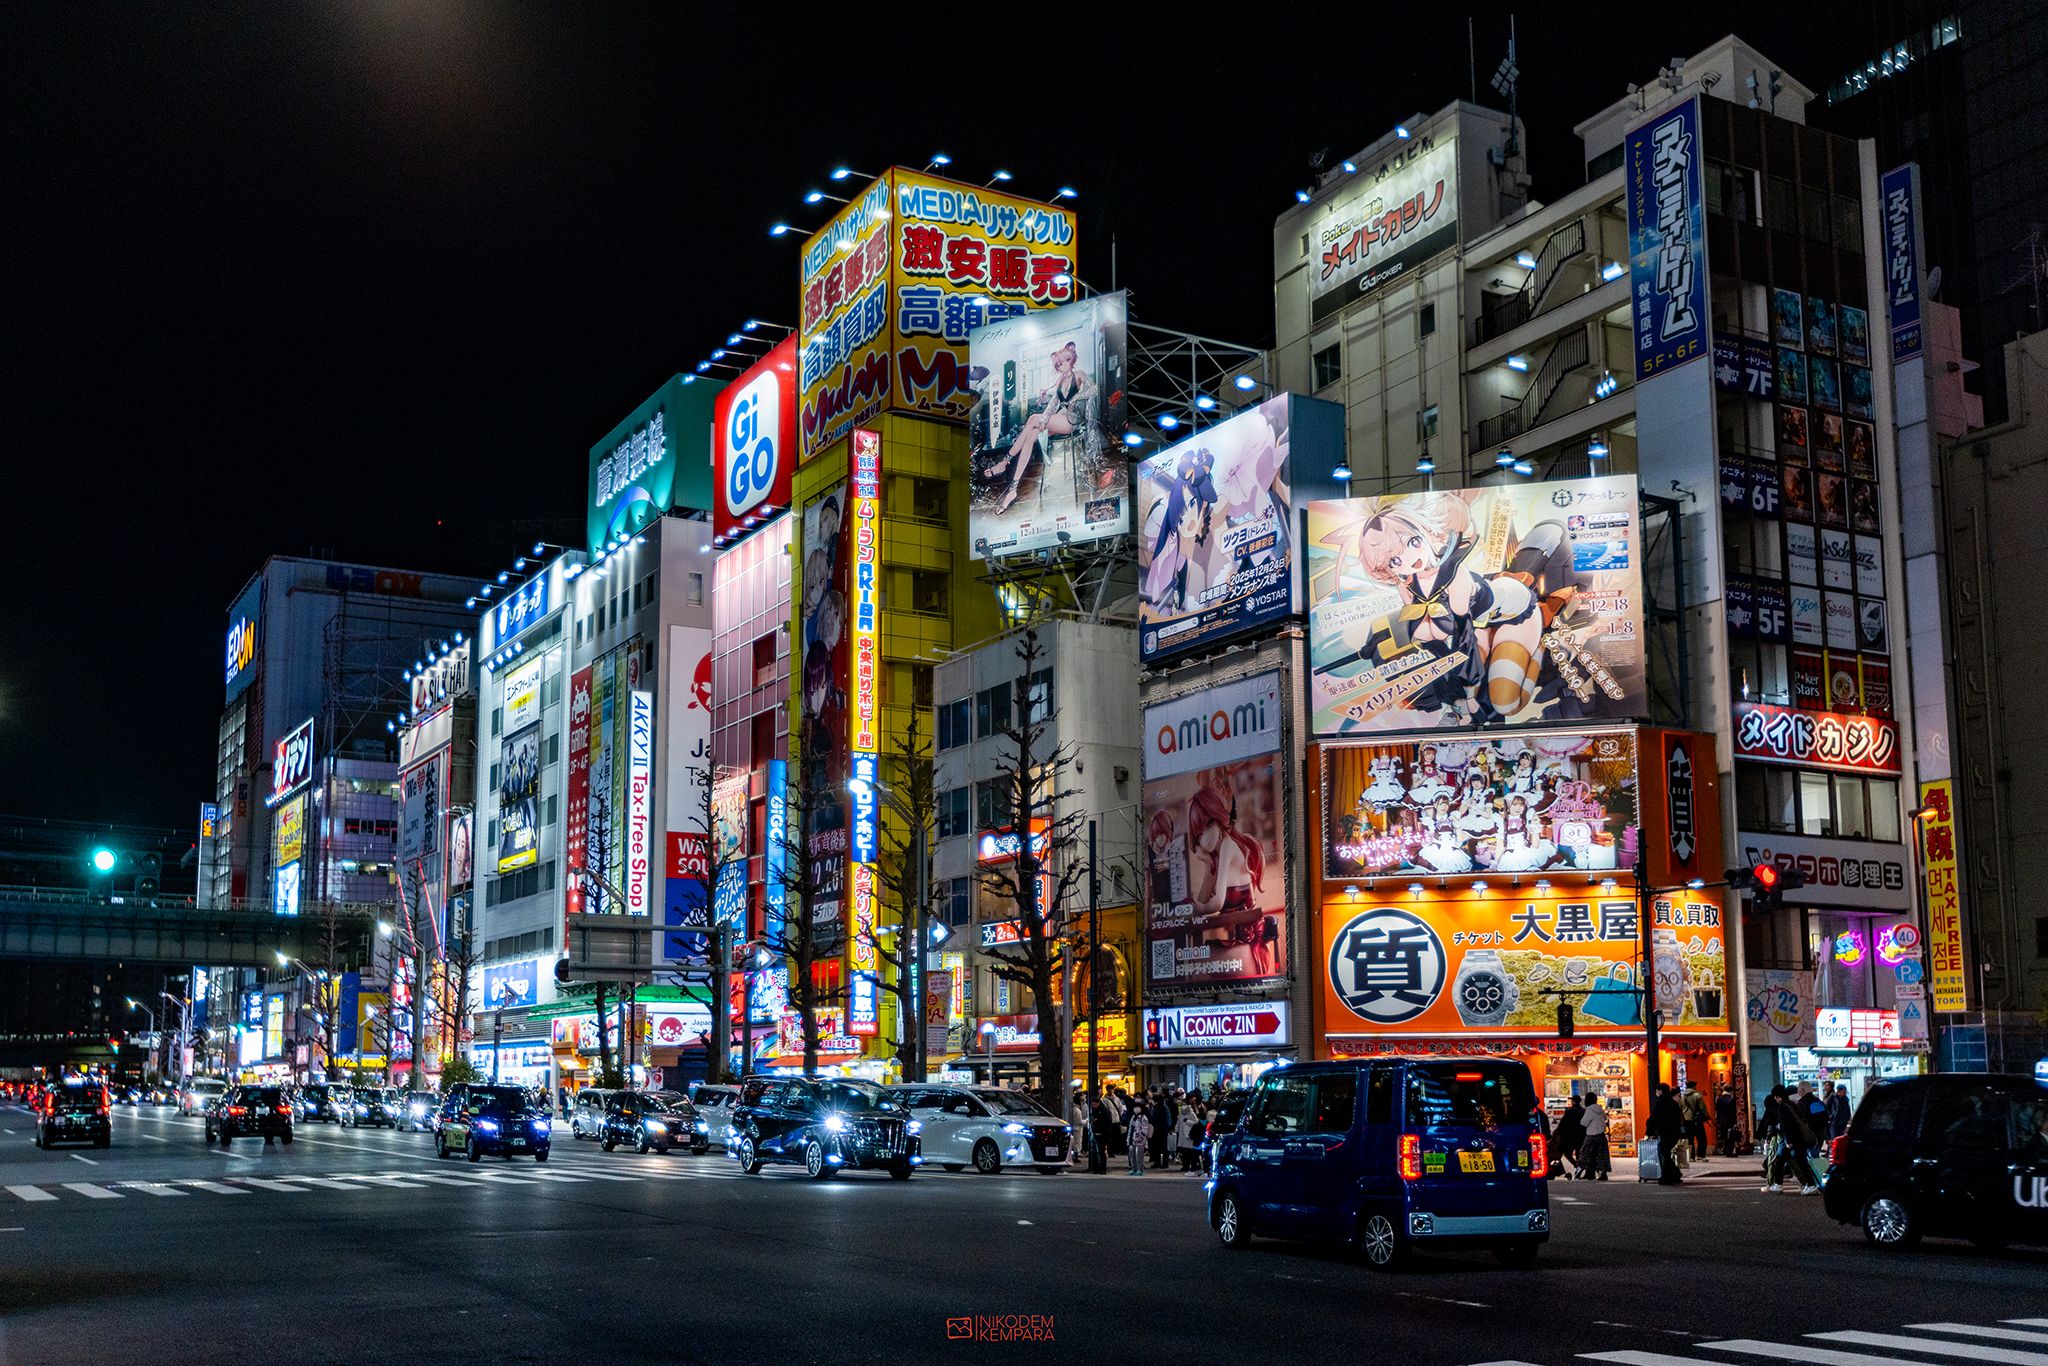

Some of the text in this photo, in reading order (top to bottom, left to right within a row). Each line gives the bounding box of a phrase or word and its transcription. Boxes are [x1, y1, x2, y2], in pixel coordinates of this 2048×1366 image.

[899, 183, 1074, 245] MEDIAリサイクル
[803, 178, 889, 286] MEDIAリサイクル
[1321, 179, 1445, 282] メイドカジノ
[901, 222, 1072, 302] 激安販売
[804, 221, 889, 335] 激安販売
[1638, 282, 1653, 350] 秋葉原店
[802, 280, 887, 395] 高額買取
[1746, 367, 1772, 396] 7F
[858, 456, 876, 469] 買取
[1752, 485, 1779, 513] 6F
[1578, 531, 1610, 539] YOSTAR
[1255, 588, 1288, 607] YOSTAR
[1590, 599, 1629, 613] 12.18
[1610, 621, 1634, 635] 1.8
[1758, 608, 1786, 635] 5F
[1348, 653, 1463, 719] ウィリアム・D・ポーター
[1359, 671, 1377, 685] CV
[633, 694, 649, 756] AKKY
[1158, 699, 1265, 755] amiami
[1739, 709, 1895, 766] メイドカジノ
[631, 772, 649, 855] Tax-free
[1923, 788, 1954, 862] 免税
[678, 838, 708, 856] WA
[629, 858, 647, 907] Shop
[1511, 901, 1641, 944] 大黒屋
[1654, 900, 1721, 928] 質&買取
[1942, 866, 1962, 972] TAX FREE
[1453, 931, 1505, 946] チケット
[1899, 930, 1915, 942] 40
[1343, 923, 1436, 1009] 質
[1901, 965, 1912, 982] P
[1778, 991, 1799, 1014] 22
[1936, 996, 1965, 1005] TOKIS
[1185, 1014, 1256, 1036] COMIC ZIN
[1819, 1026, 1848, 1038] TOKIS
[1184, 1037, 1224, 1046] Akihabara
